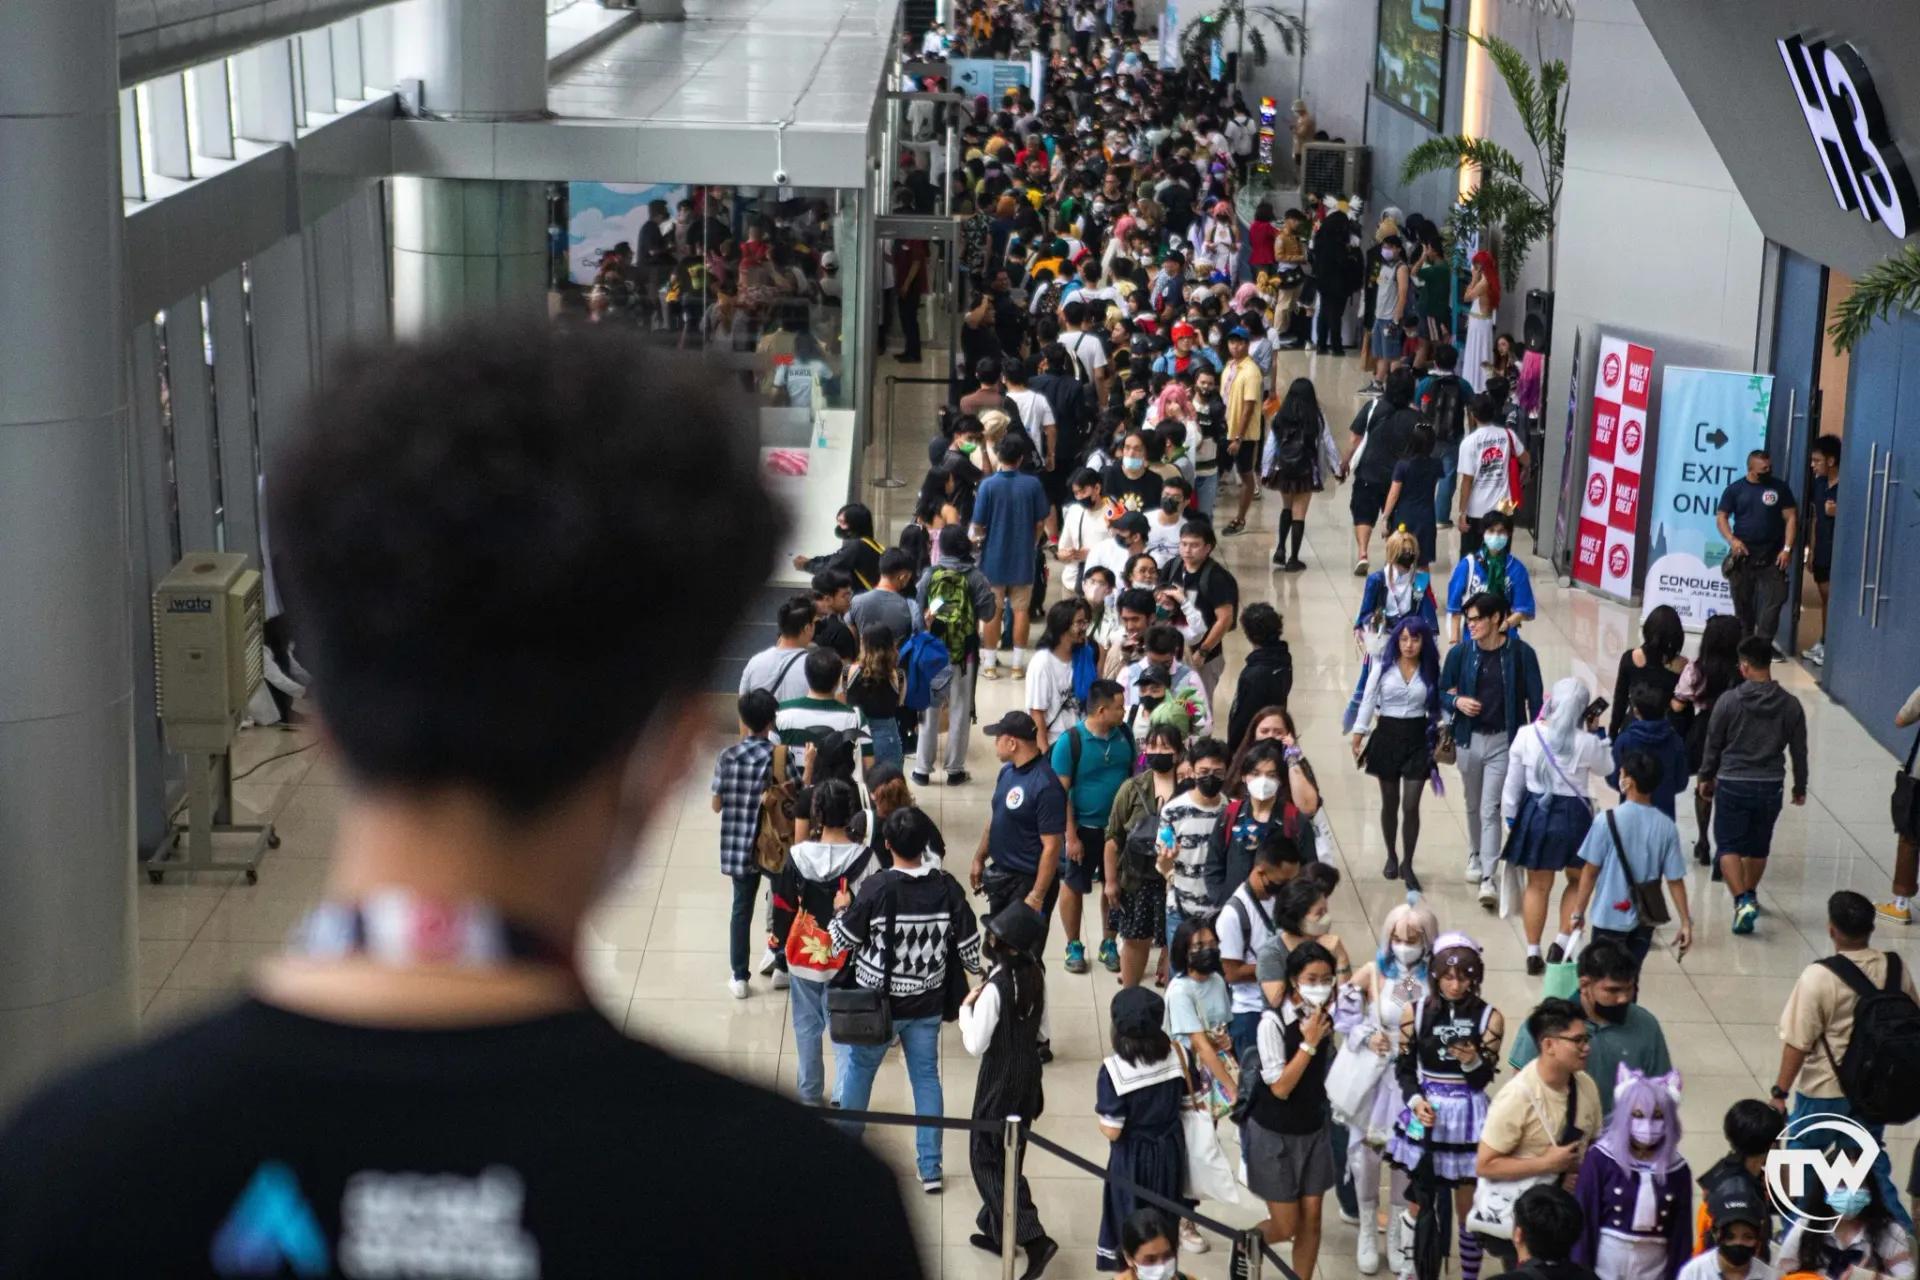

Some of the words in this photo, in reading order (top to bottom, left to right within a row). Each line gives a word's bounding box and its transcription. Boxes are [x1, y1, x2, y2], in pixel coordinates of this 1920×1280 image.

[1776, 38, 1906, 239] H3
[1682, 462, 1738, 486] EXIT
[1673, 493, 1720, 516] ONL
[1659, 575, 1730, 592] CONQUES
